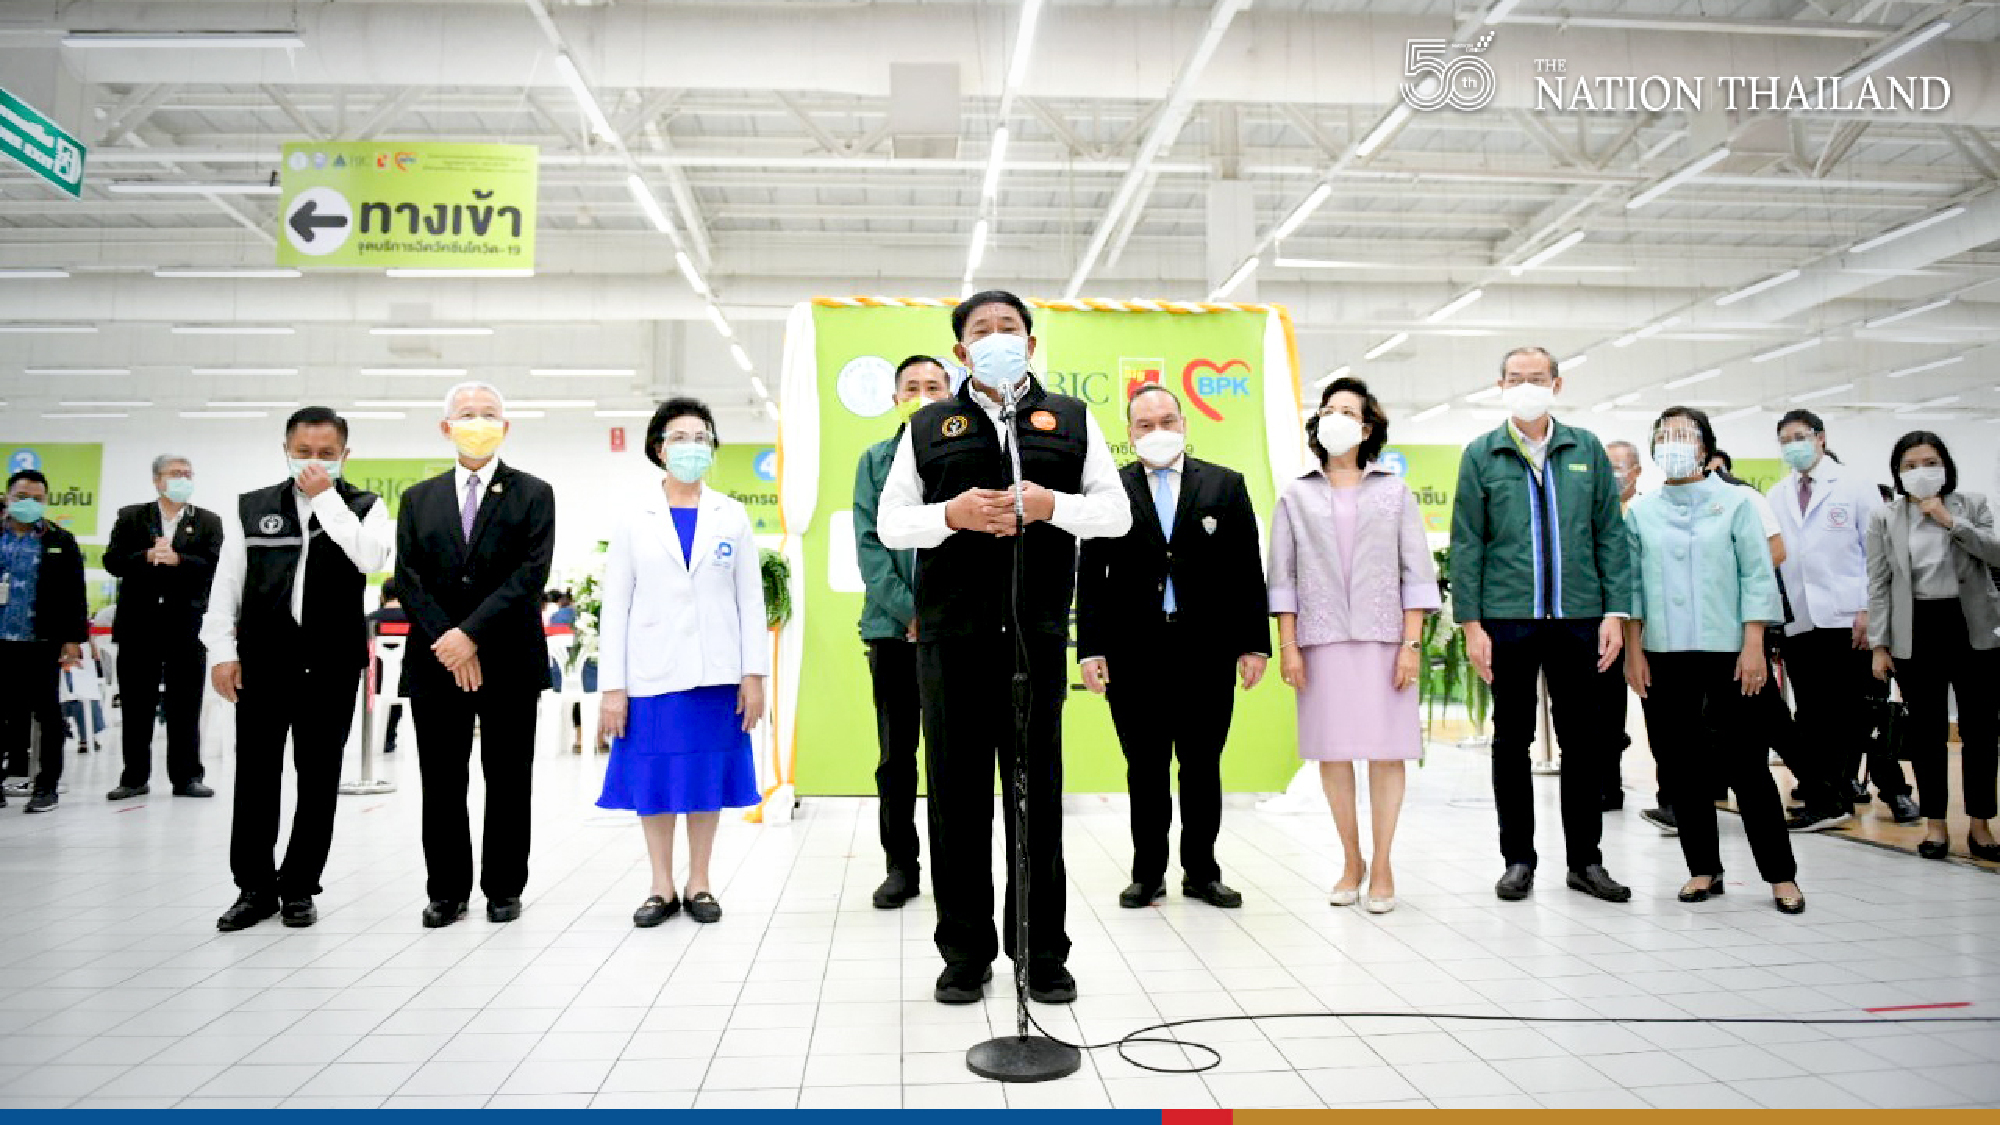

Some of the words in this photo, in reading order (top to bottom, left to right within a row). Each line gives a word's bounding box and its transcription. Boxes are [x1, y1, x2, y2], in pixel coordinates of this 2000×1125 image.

[359, 188, 523, 239] ทางเข้า
[1197, 376, 1251, 397] BPK
